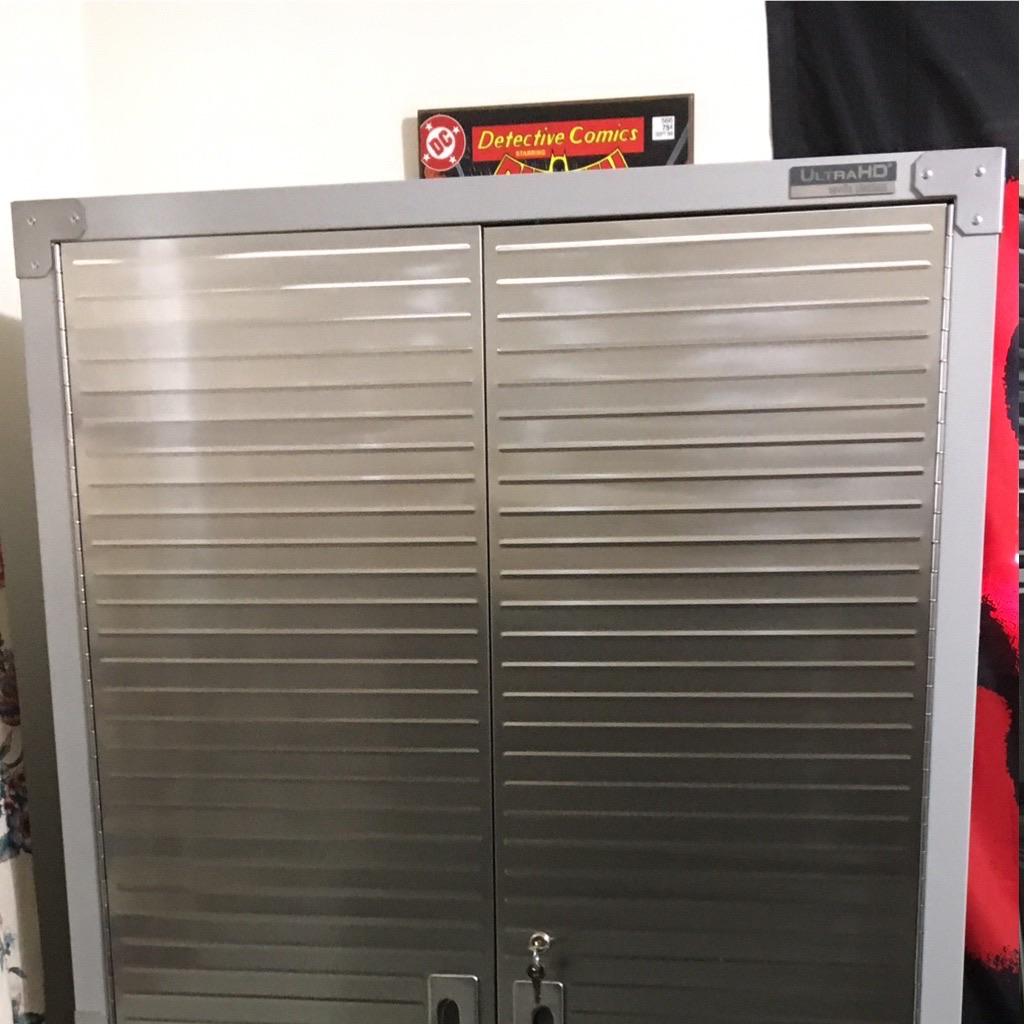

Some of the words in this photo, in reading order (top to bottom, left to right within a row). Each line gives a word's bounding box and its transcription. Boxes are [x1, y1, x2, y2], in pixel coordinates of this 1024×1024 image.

[429, 130, 453, 157] DC
[477, 126, 565, 151] Detective
[568, 122, 640, 146] Comics
